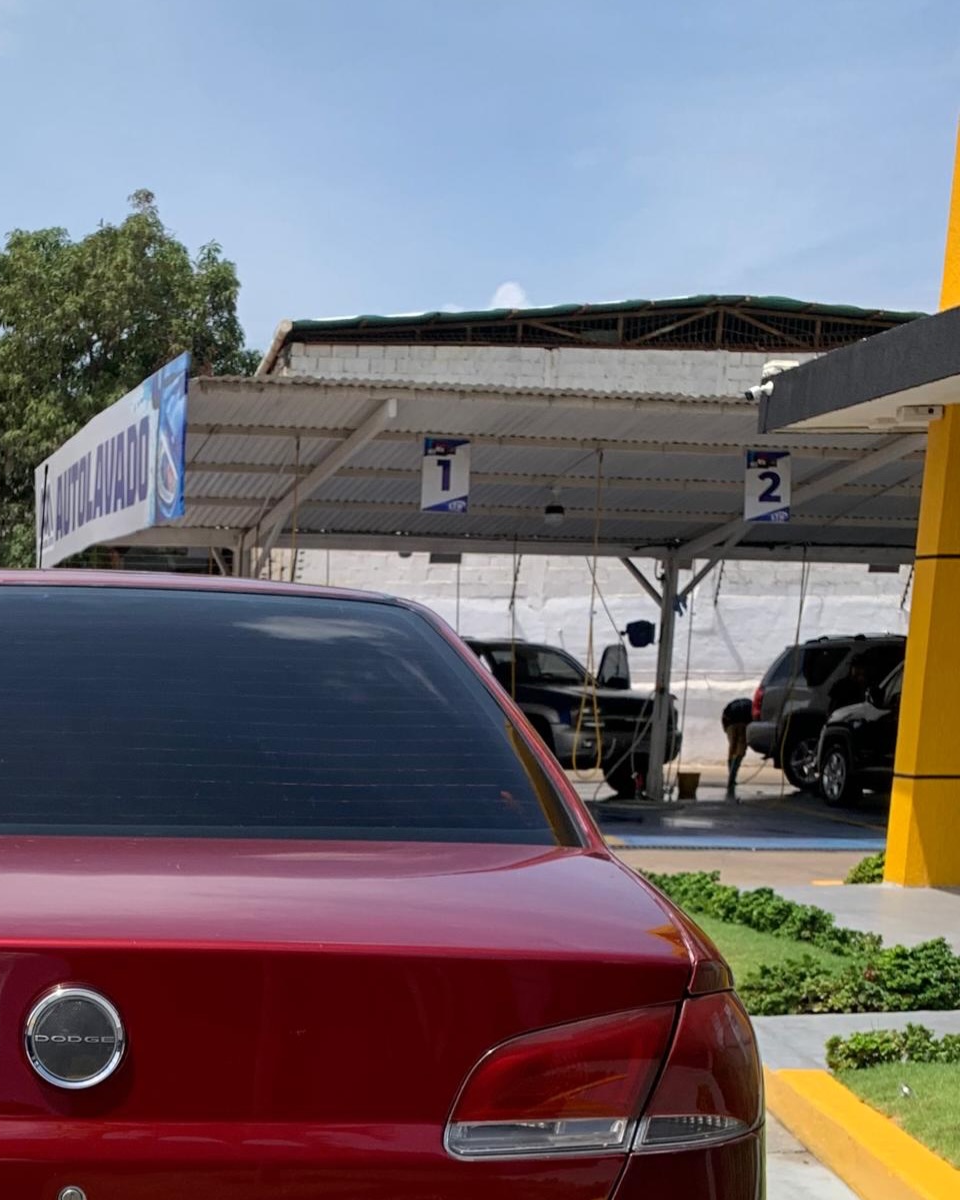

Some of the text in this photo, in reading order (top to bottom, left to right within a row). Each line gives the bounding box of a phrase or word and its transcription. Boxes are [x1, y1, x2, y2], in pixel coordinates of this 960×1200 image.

[55, 415, 150, 541] AUTOLAVADO
[437, 459, 451, 491] 1
[758, 471, 781, 502] 2
[34, 1034, 115, 1044] DODGE
